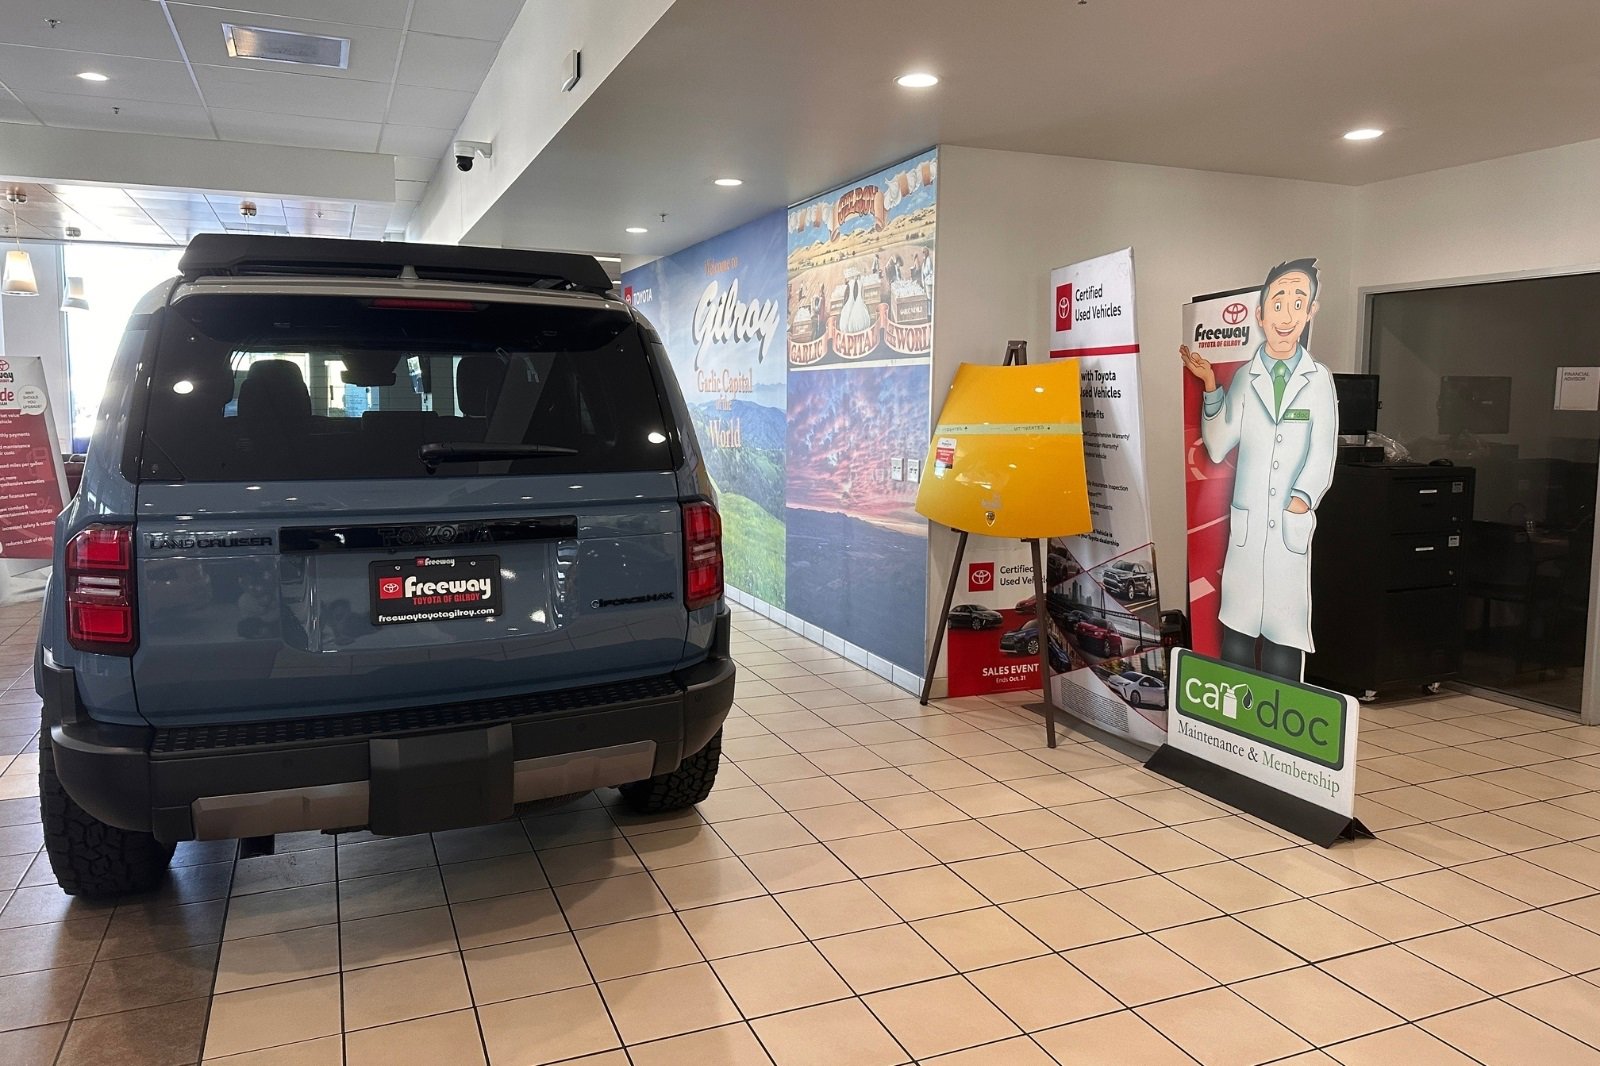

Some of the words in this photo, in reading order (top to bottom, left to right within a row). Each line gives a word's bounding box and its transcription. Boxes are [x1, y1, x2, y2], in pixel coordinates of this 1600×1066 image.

[633, 288, 653, 305] TOYOTA
[1075, 284, 1103, 301] Certified
[1075, 308, 1091, 321] Used
[1092, 304, 1122, 320] Vehicles
[692, 278, 780, 371] Gilroy
[1194, 324, 1250, 345] freeway
[791, 340, 823, 363] GARLIC
[697, 369, 721, 393] Garlic
[722, 368, 752, 397] Capital
[1081, 370, 1093, 381] with
[1095, 370, 1116, 384] Toyota
[1093, 386, 1121, 399] Vehicles
[1085, 410, 1105, 419] Benefits
[709, 418, 741, 448] World
[151, 538, 195, 550] LAND
[197, 536, 273, 548] CRUISER
[378, 524, 493, 546] TOYOTA
[424, 558, 456, 567] freeway
[404, 576, 492, 600] freeway
[1000, 577, 1021, 586] Used
[413, 597, 441, 606] TOYOTA
[454, 593, 480, 602] GILROY
[378, 608, 495, 622] freewaytoyotagilroy.com
[982, 665, 1009, 677] SALES
[1011, 663, 1039, 674] EVENT
[1256, 689, 1329, 746] doc
[1178, 719, 1245, 757] Maintenance
[1247, 746, 1259, 763] &
[1262, 750, 1340, 798] Membership
